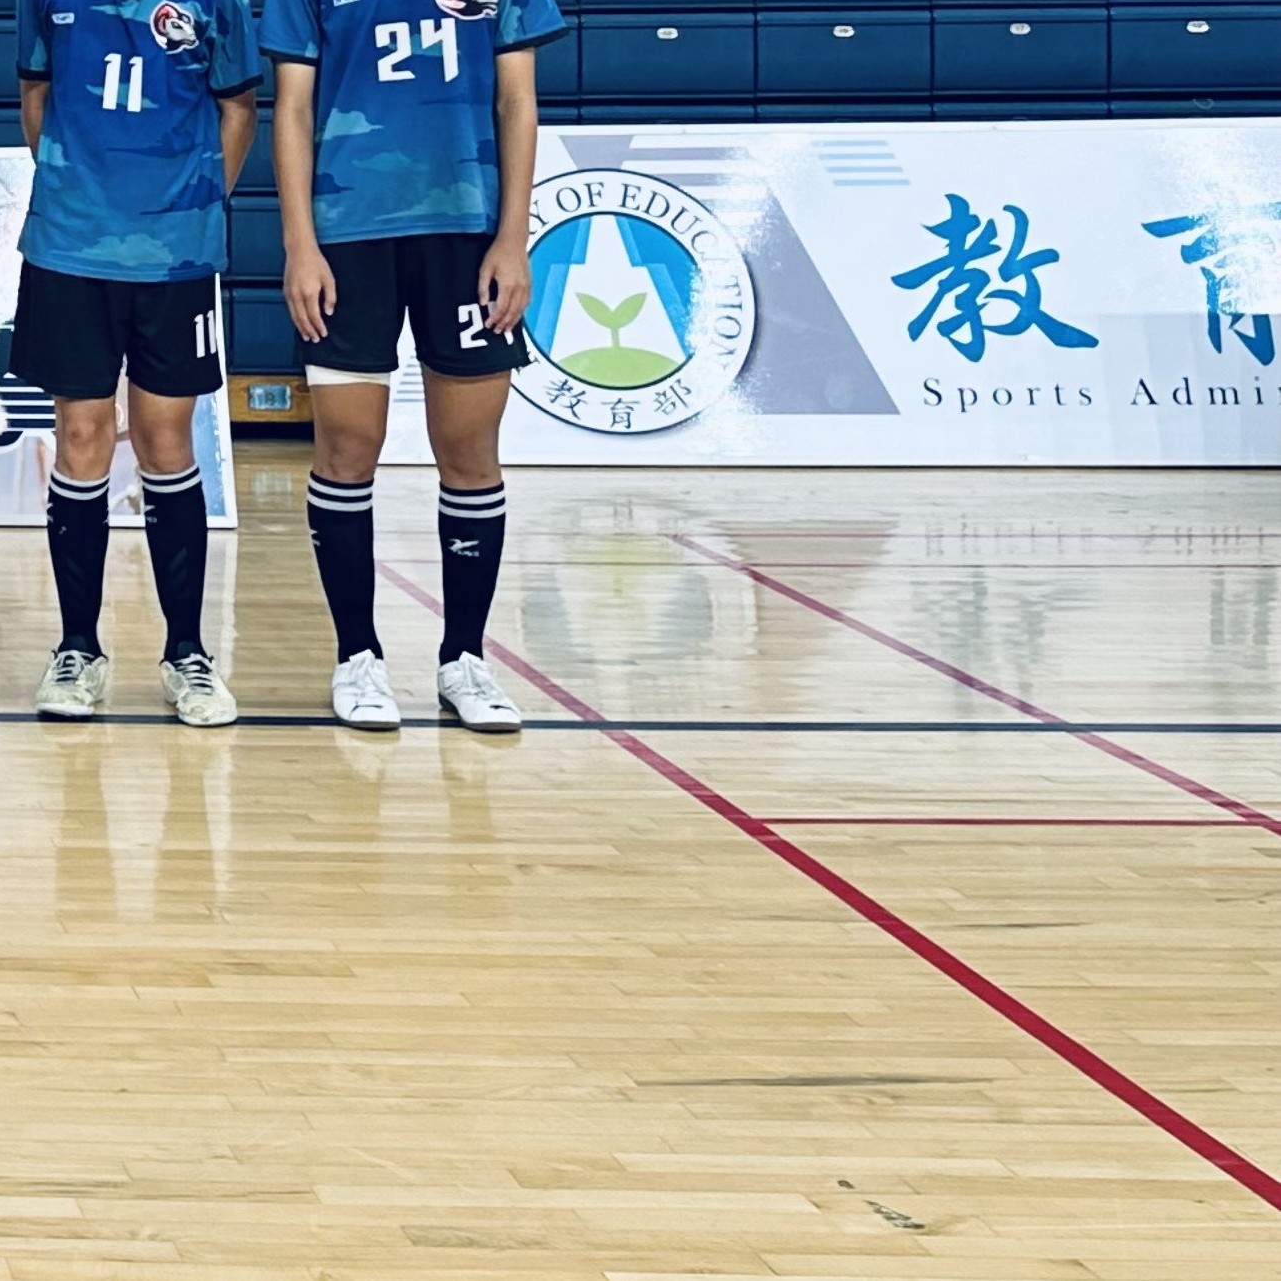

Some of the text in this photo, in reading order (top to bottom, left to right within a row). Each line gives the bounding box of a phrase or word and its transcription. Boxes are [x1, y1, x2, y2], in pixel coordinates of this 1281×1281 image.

[375, 18, 458, 84] 24
[102, 53, 143, 112] 11
[555, 182, 605, 213] OF
[193, 309, 217, 359] 11
[458, 303, 514, 349] 2
[544, 378, 693, 430] 教育部
[923, 375, 1281, 414] Sports Admi
